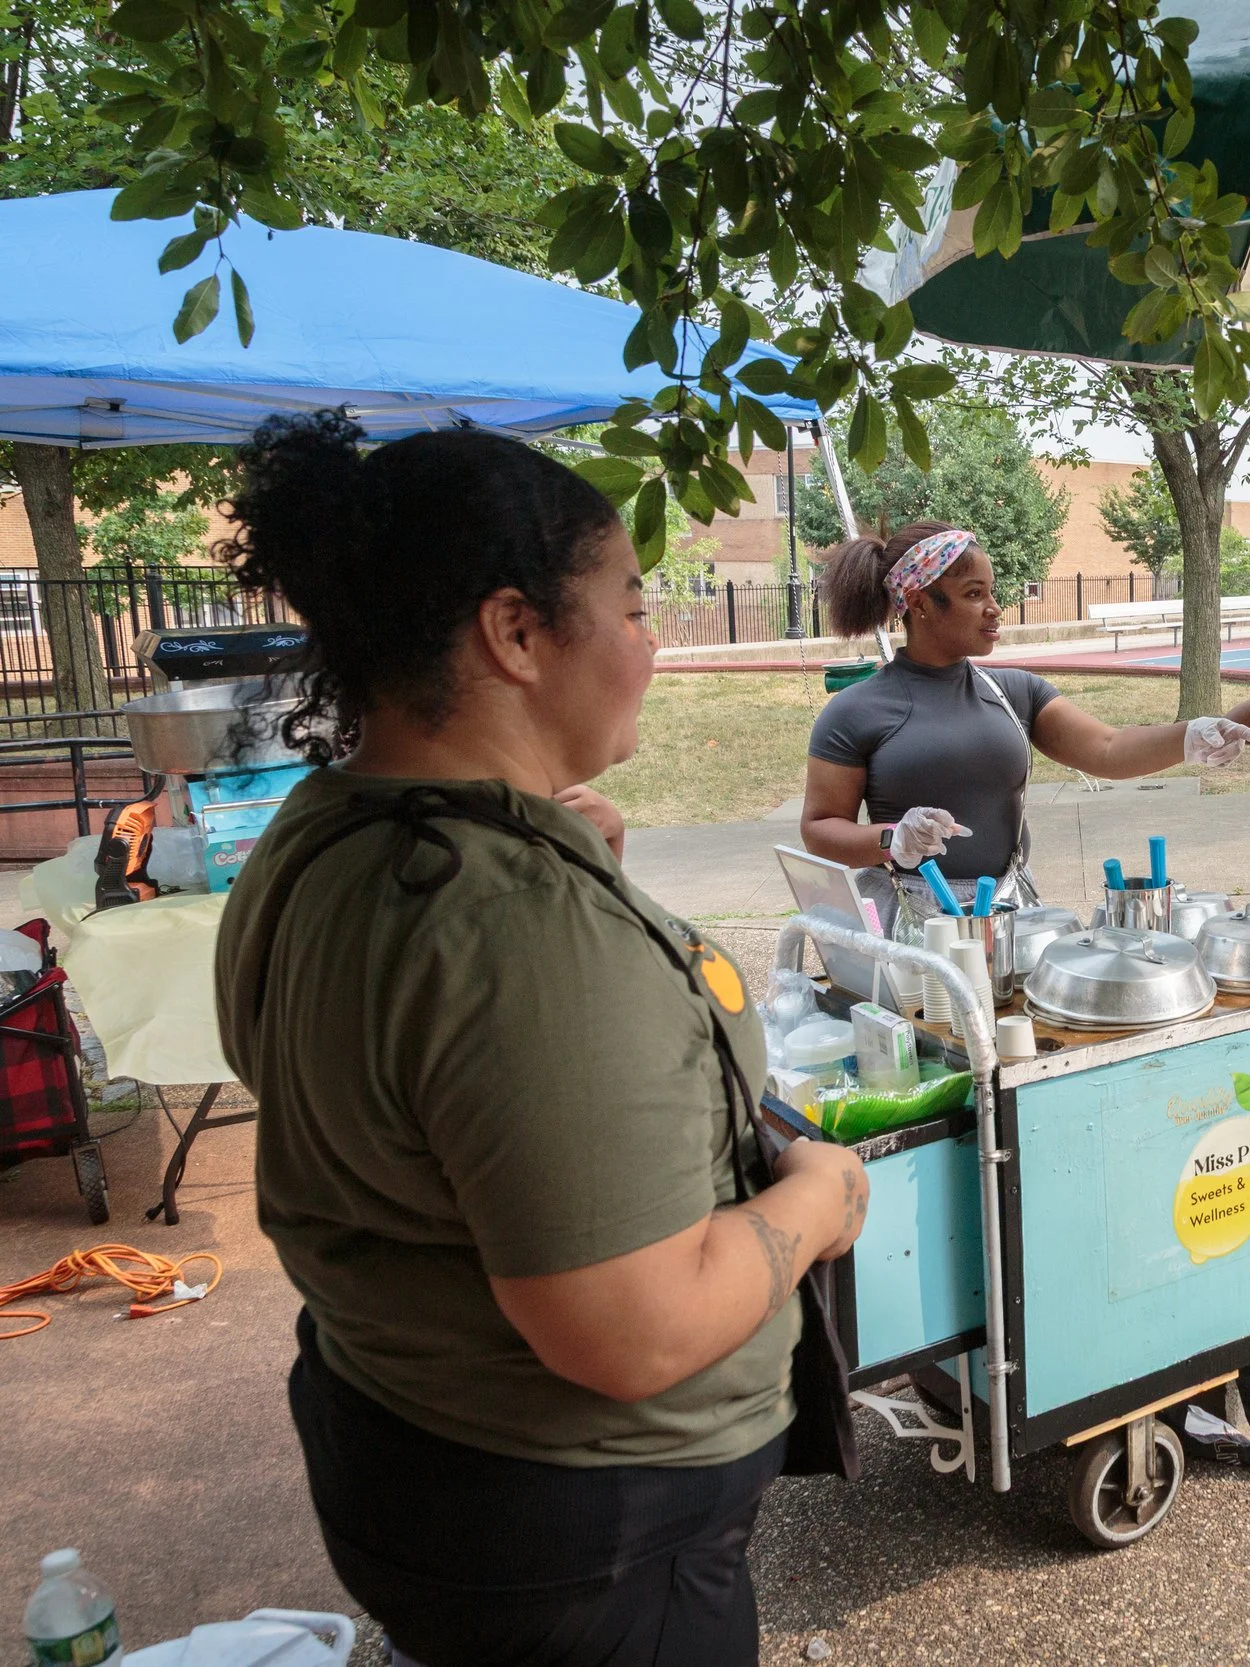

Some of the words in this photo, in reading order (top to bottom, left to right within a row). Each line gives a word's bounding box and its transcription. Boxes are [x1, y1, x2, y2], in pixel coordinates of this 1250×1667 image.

[1194, 1153, 1234, 1177] Miss
[1190, 1182, 1233, 1206] Sweets
[1236, 1176, 1246, 1191] &
[1189, 1201, 1246, 1228] Wellness
